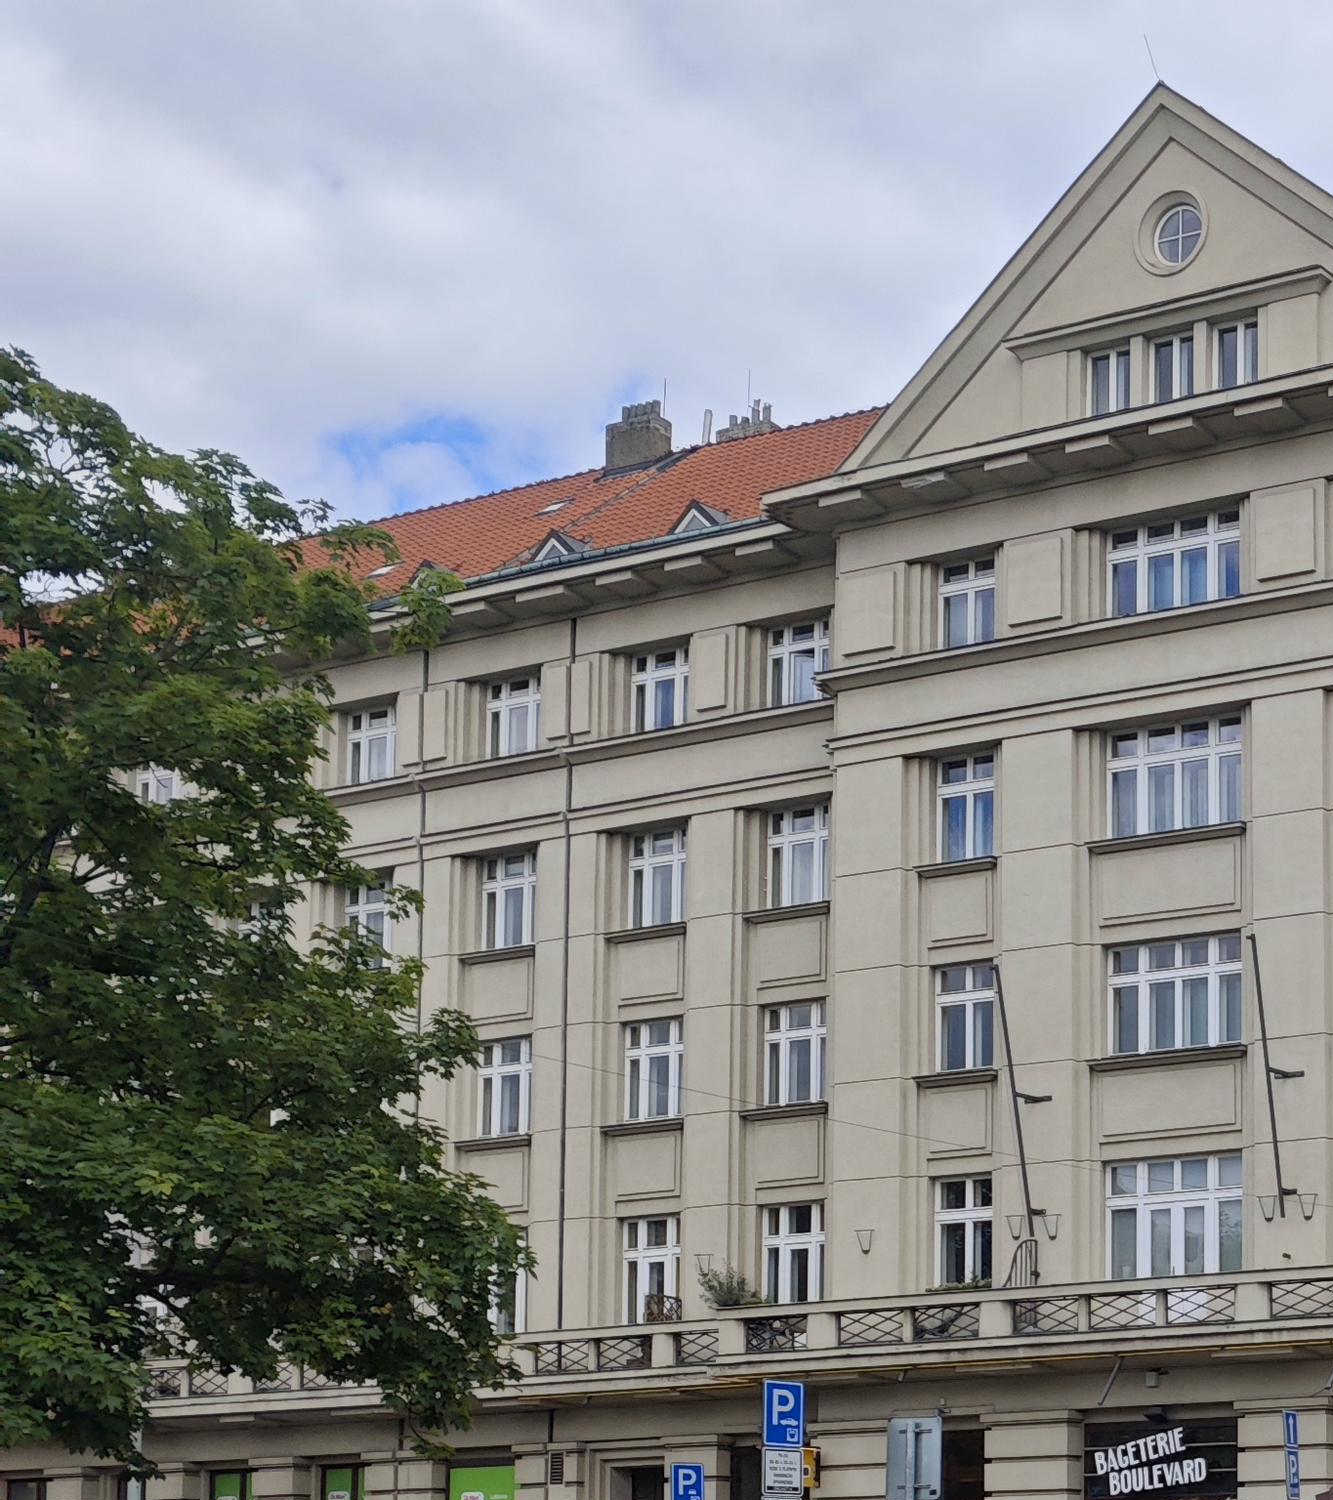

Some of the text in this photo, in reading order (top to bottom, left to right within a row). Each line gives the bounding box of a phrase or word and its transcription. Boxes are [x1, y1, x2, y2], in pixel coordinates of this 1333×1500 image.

[771, 1388, 795, 1426] P
[1094, 1426, 1187, 1476] BAGETERIE
[678, 1468, 697, 1496] P
[1108, 1457, 1208, 1496] BOULEVARD
